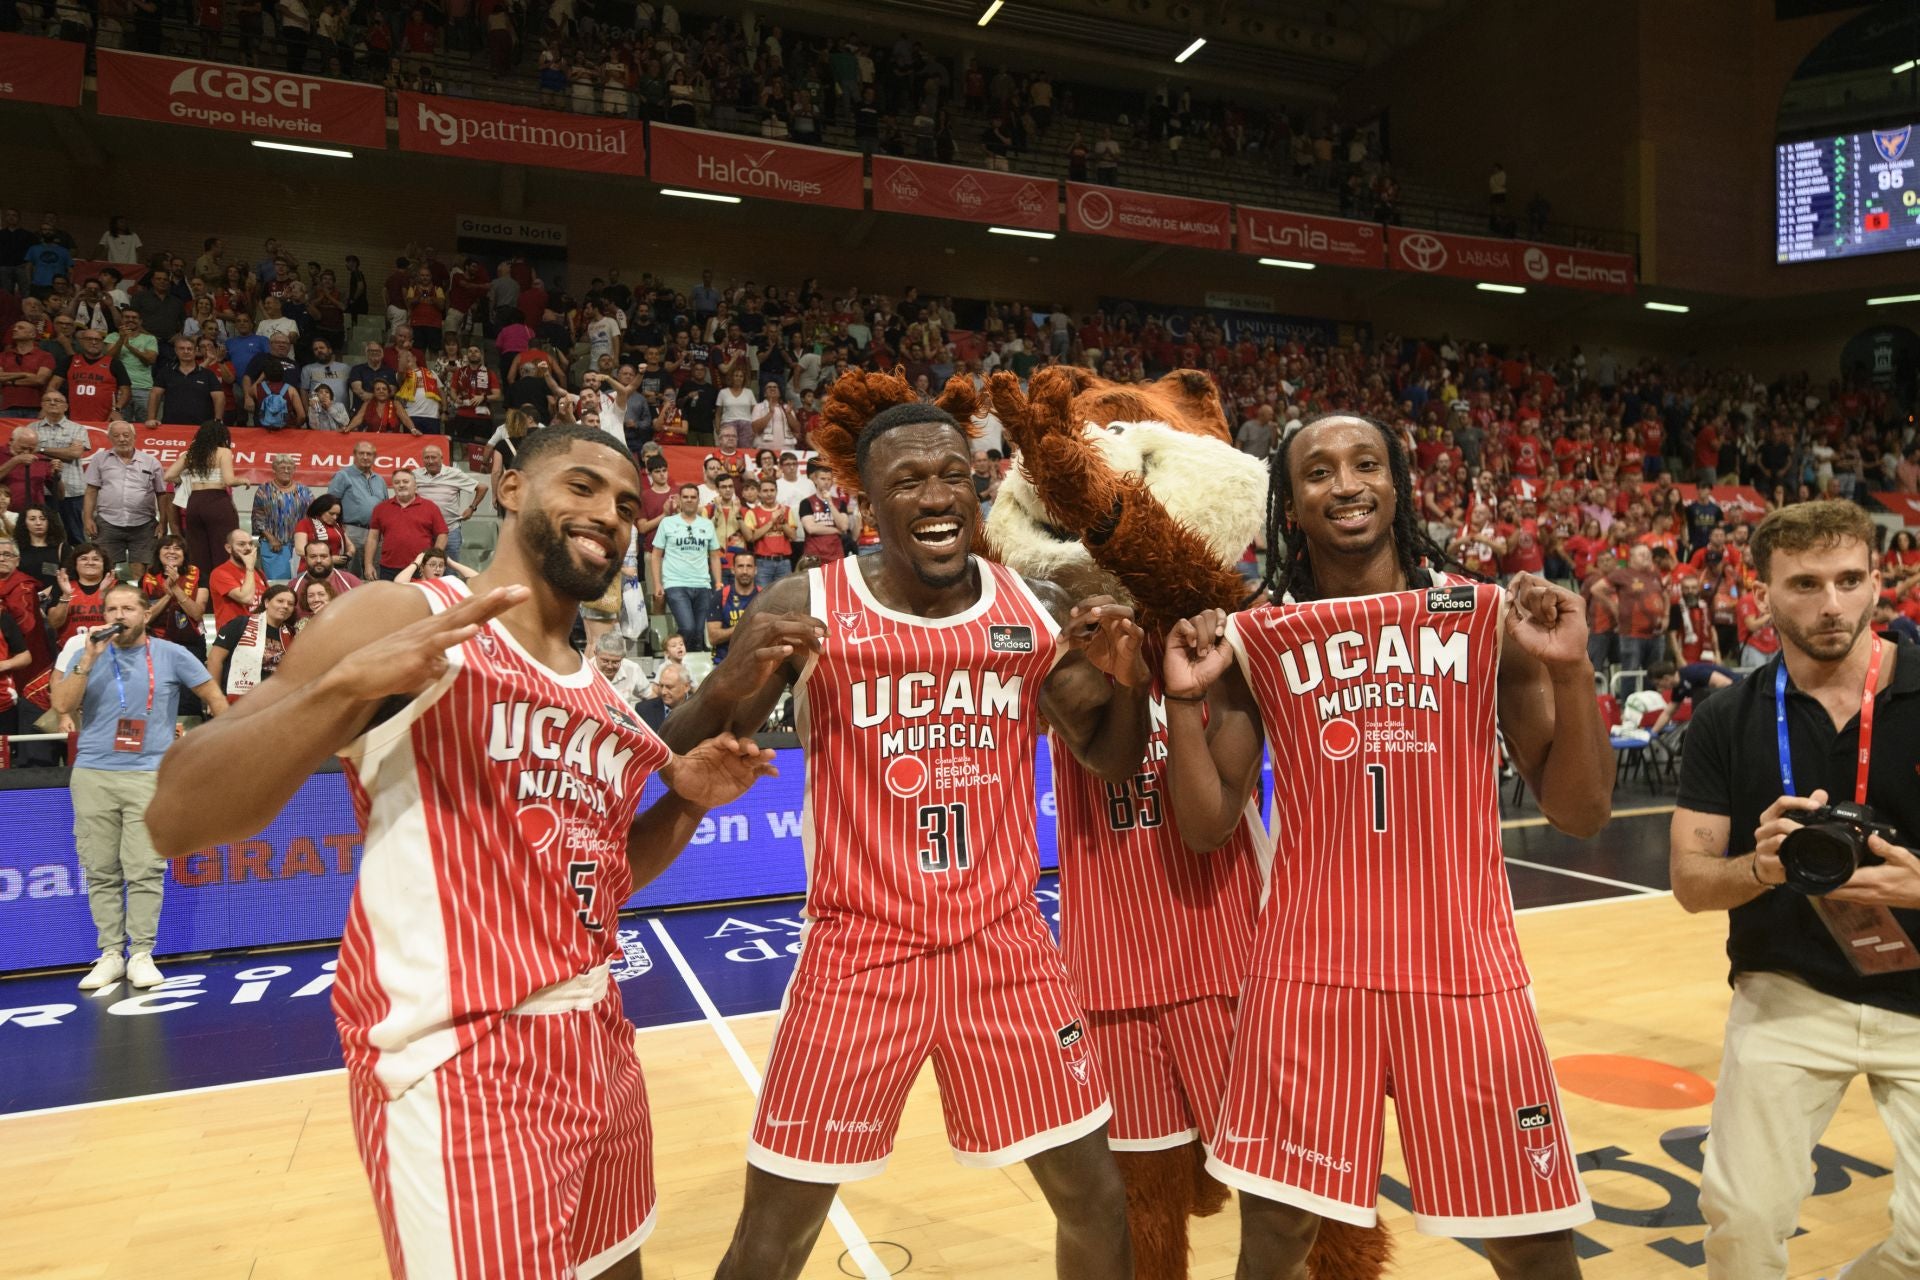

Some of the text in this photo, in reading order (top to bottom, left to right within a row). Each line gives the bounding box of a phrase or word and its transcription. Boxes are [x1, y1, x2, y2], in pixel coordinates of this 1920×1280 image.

[200, 67, 321, 109] caser
[169, 101, 322, 134] Grupo Helvetia
[460, 117, 628, 155] patrimonial
[780, 178, 821, 198] viajes
[892, 184, 919, 198] Niña
[956, 191, 982, 207] Niña
[462, 220, 563, 241] Grada Norte
[1119, 212, 1221, 236] REGIÓN DE MURCIA
[1249, 216, 1329, 251] Lunia
[1456, 250, 1512, 269] LABASA
[1555, 255, 1628, 285] dama
[76, 384, 97, 396] 00
[143, 437, 187, 447] Costa
[311, 453, 421, 469] MUCIA
[676, 537, 706, 548] UCAM
[1430, 600, 1472, 610] endesa
[1431, 592, 1450, 604] liga
[993, 631, 1011, 644] liga
[994, 640, 1031, 650] endesa
[1279, 624, 1470, 697] UCAM
[850, 668, 1024, 729] UCAM
[1317, 681, 1440, 721] MURCIA
[880, 723, 997, 759] MURCIA
[1364, 727, 1415, 741] REGIÓN
[488, 701, 635, 800] UCAM
[1364, 741, 1438, 754] DE MURCIA
[934, 762, 981, 779] REGIÓN
[935, 772, 1001, 790] DE MURCIA
[517, 769, 608, 820] MURCIA
[1105, 770, 1163, 832] 85
[1366, 763, 1386, 833] 1
[1836, 809, 1859, 819] SONY
[918, 802, 971, 873] 31
[568, 860, 605, 933] 5
[1062, 1030, 1080, 1046] acb
[1520, 1114, 1546, 1128] acb
[1280, 1138, 1354, 1174] INVERSUS
